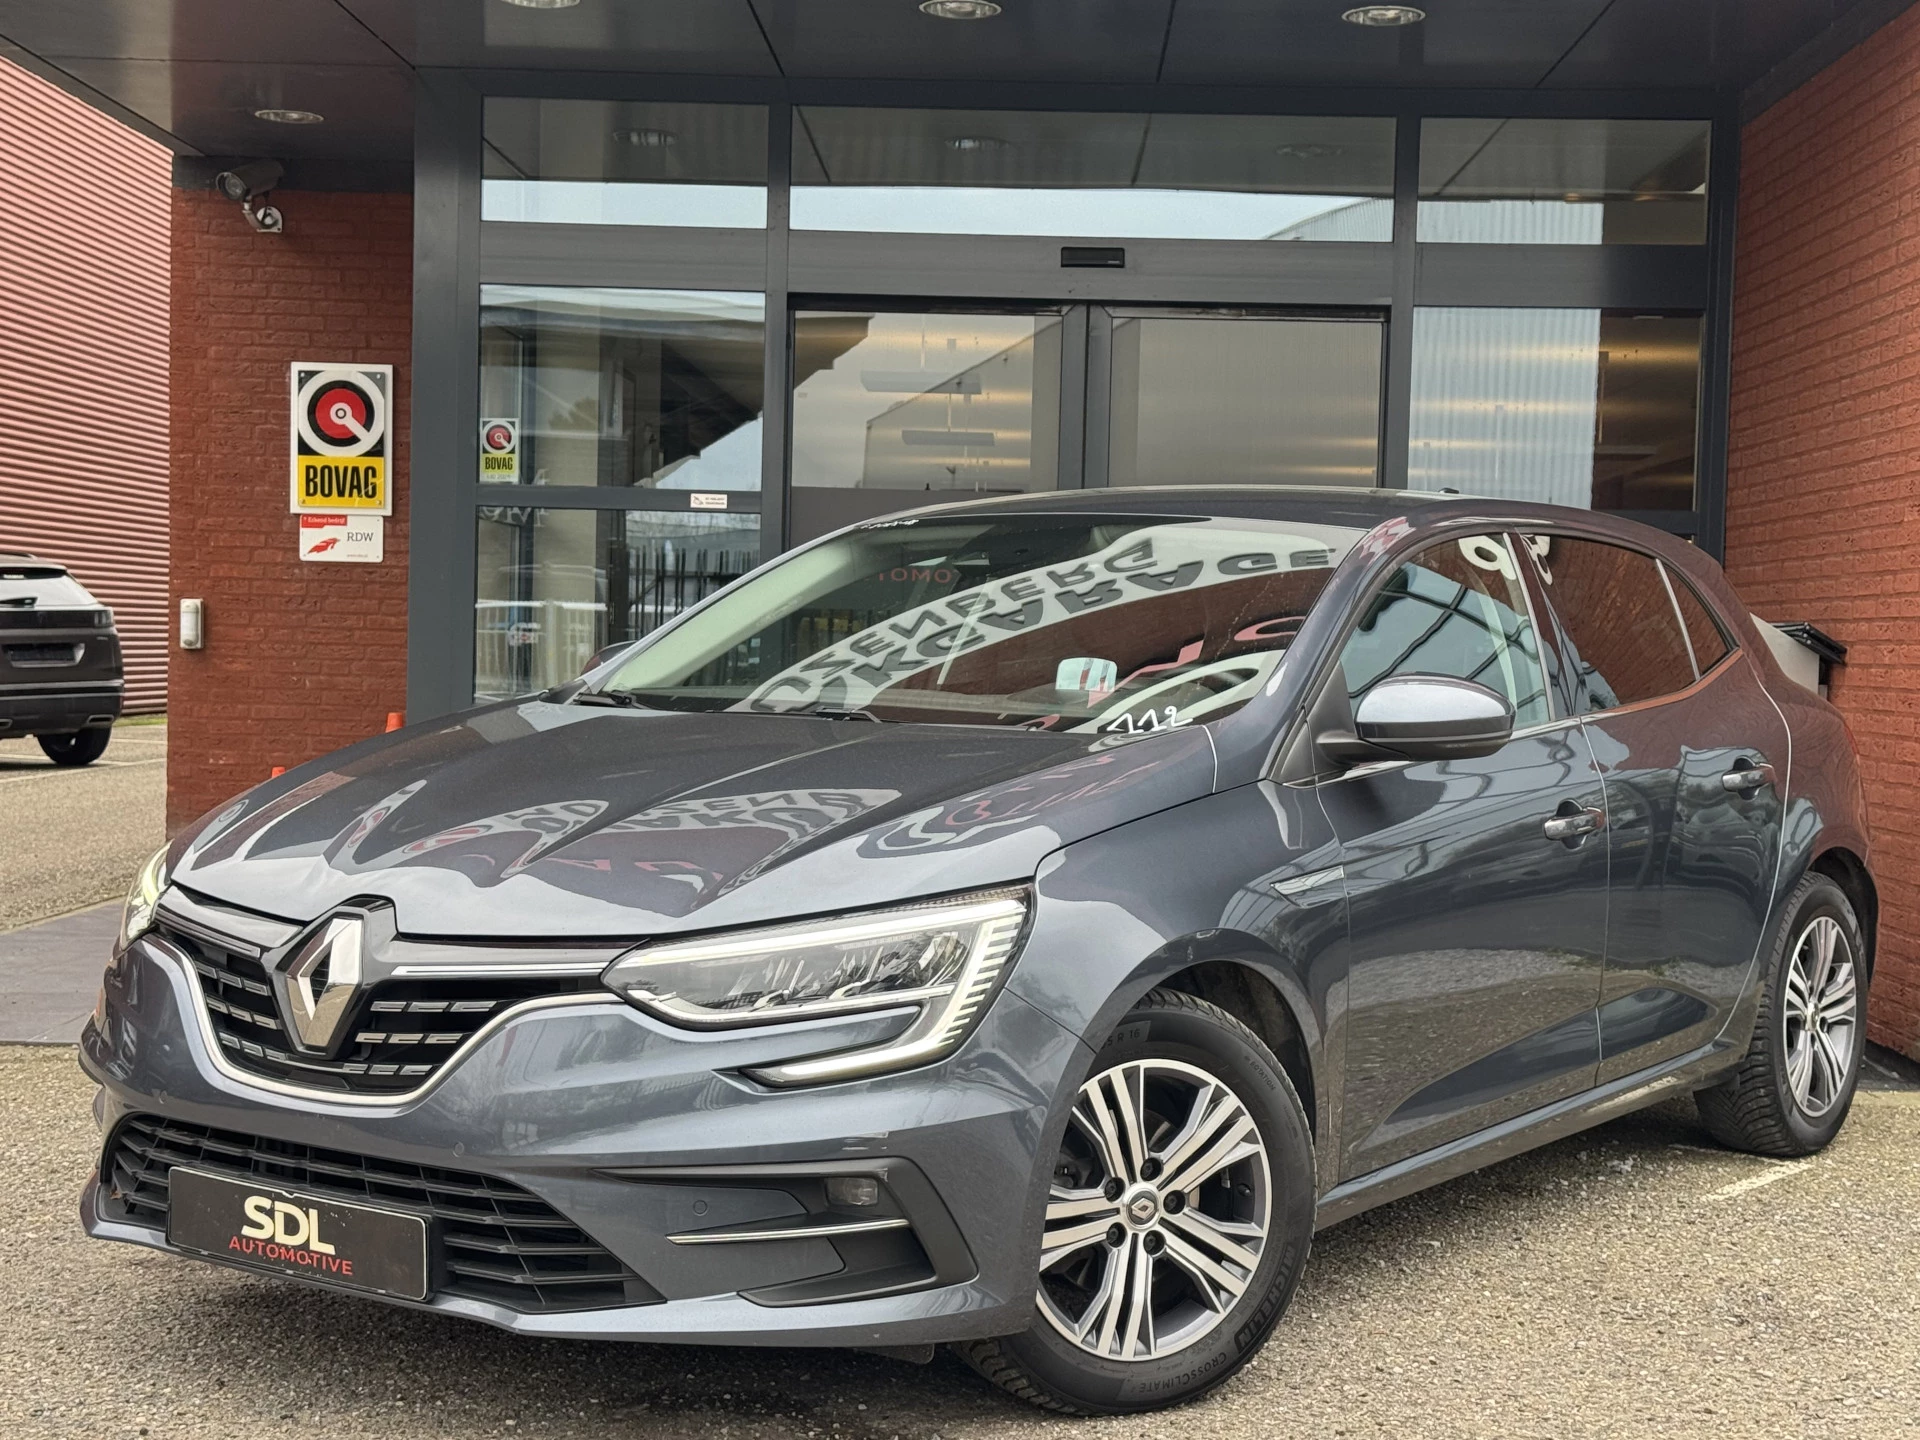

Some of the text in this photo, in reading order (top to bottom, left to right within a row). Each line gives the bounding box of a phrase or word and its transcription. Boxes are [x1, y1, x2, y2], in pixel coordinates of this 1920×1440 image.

[305, 465, 377, 498] BOVAG
[485, 456, 513, 471] BOVAG
[347, 532, 374, 542] RDW
[1107, 705, 1194, 734] 112
[241, 1195, 336, 1255] SDL
[229, 1236, 353, 1276] AUTOMOTIVE
[1237, 1244, 1296, 1347] MICHELIN
[1139, 1351, 1227, 1393] CROSSCLIMATE
